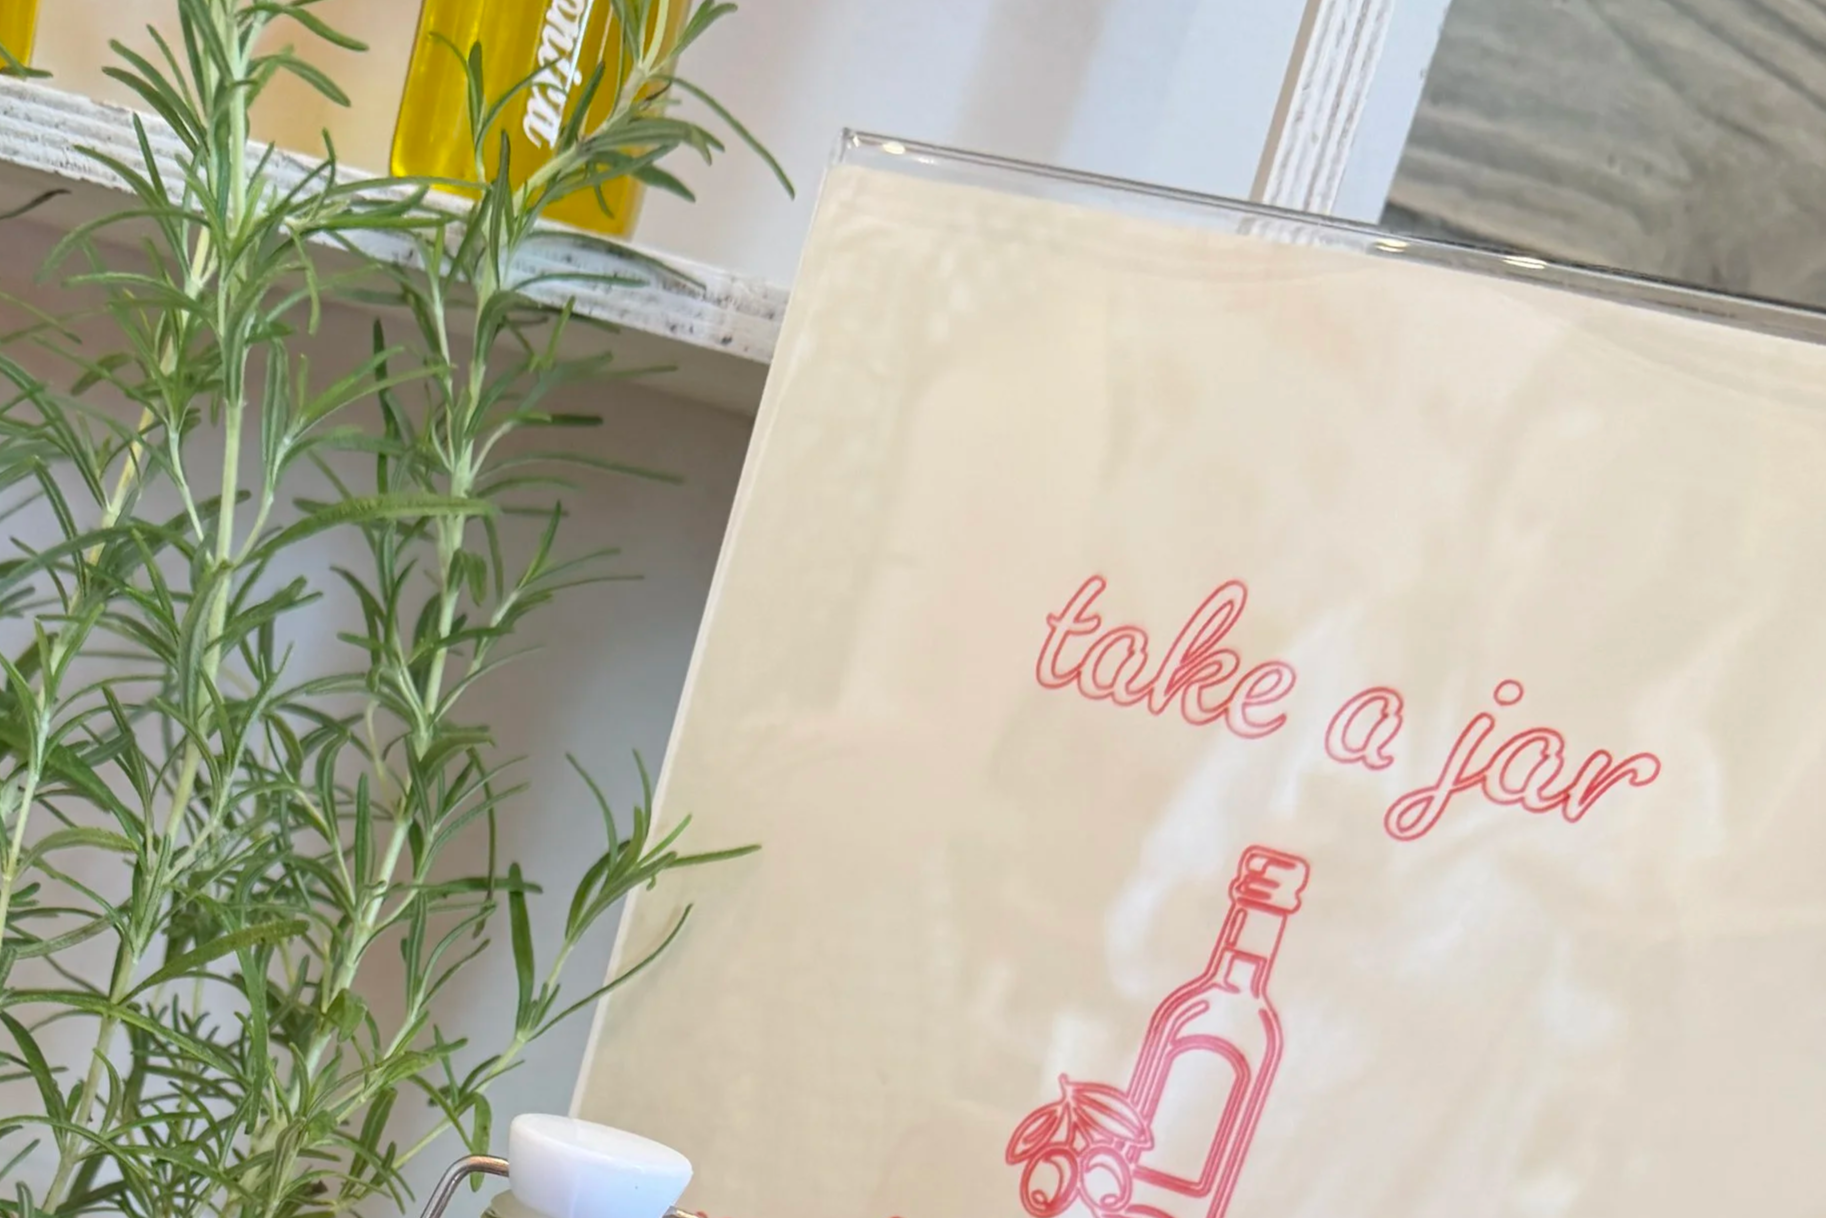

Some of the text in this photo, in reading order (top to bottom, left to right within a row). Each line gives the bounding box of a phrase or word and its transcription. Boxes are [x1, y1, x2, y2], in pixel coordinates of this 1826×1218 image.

[1036, 574, 1661, 842] take a jar
